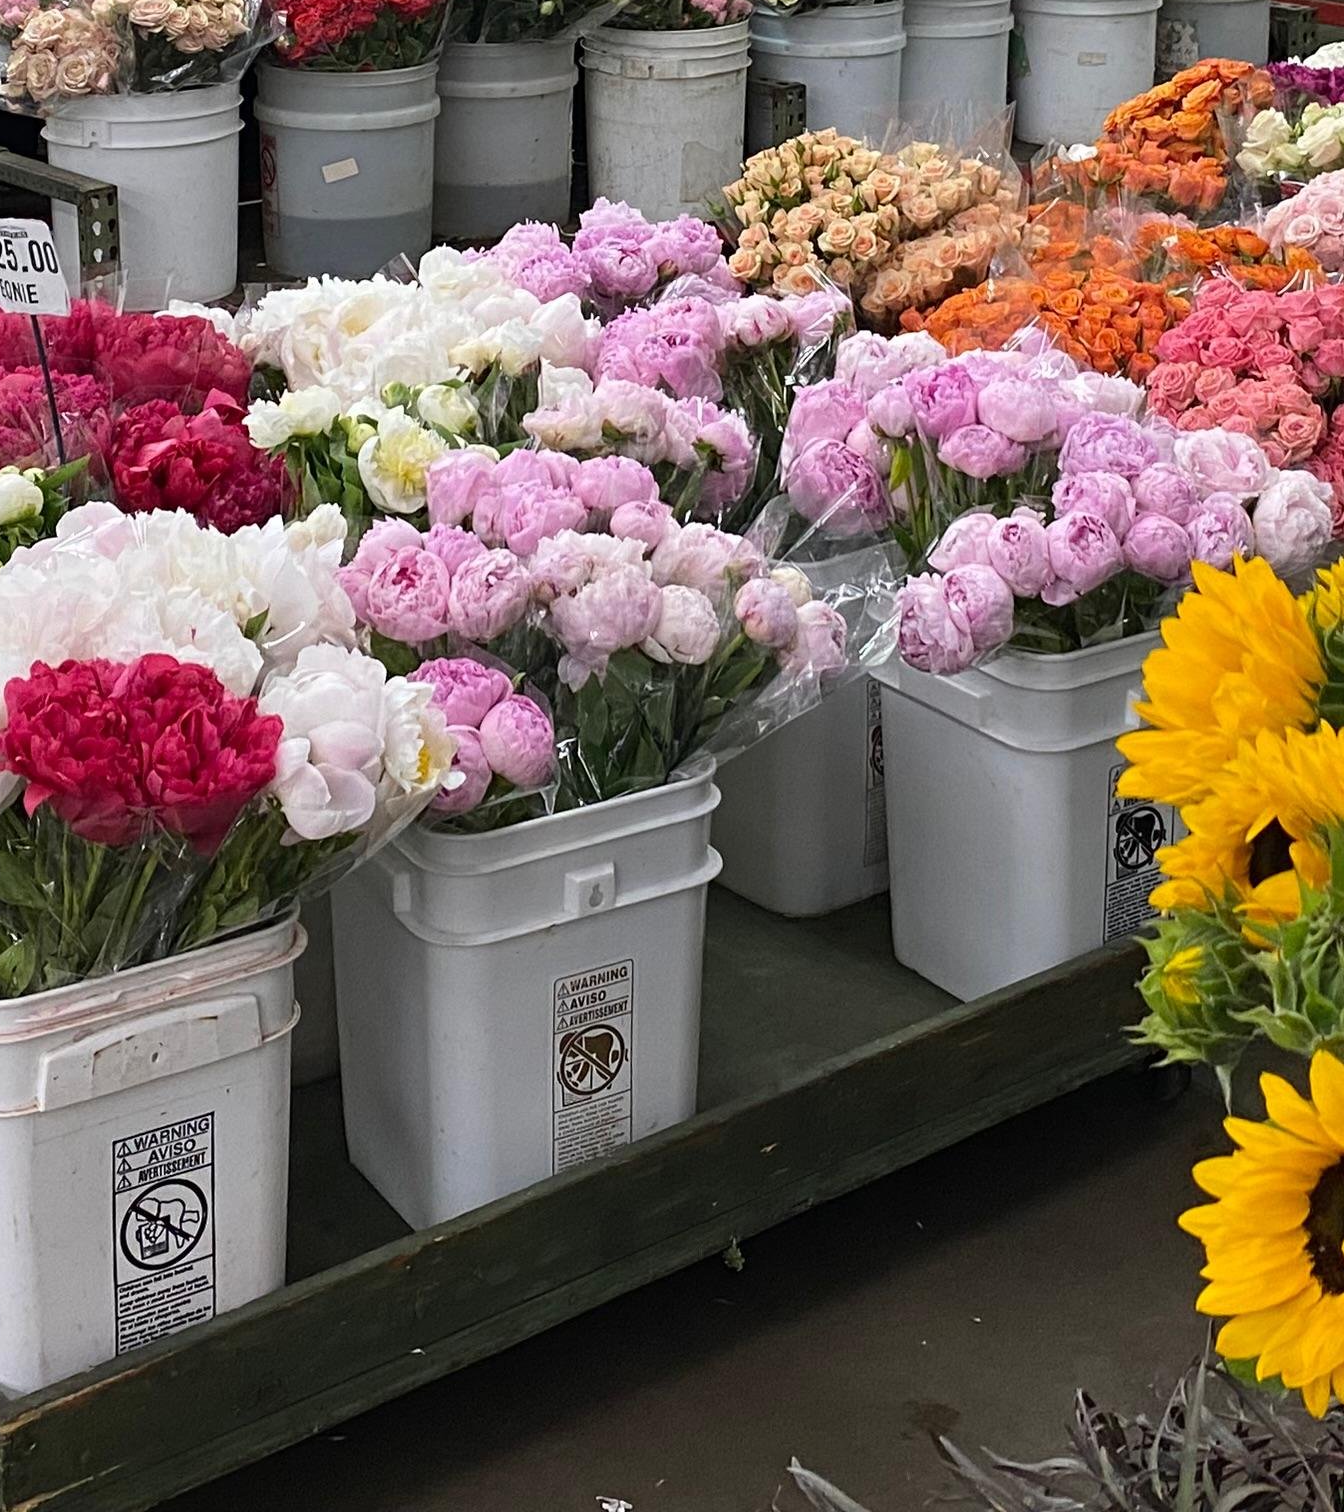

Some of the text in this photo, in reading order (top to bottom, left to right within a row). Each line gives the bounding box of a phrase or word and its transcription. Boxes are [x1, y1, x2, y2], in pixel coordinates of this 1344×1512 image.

[570, 966, 628, 992] WARNING
[570, 990, 607, 1010] AVISO
[570, 1000, 628, 1026] AVERTISSEMENT
[134, 1118, 210, 1151] WARNING
[148, 1139, 196, 1164] AVISO
[138, 1152, 206, 1183] AVERTISSEMENT
